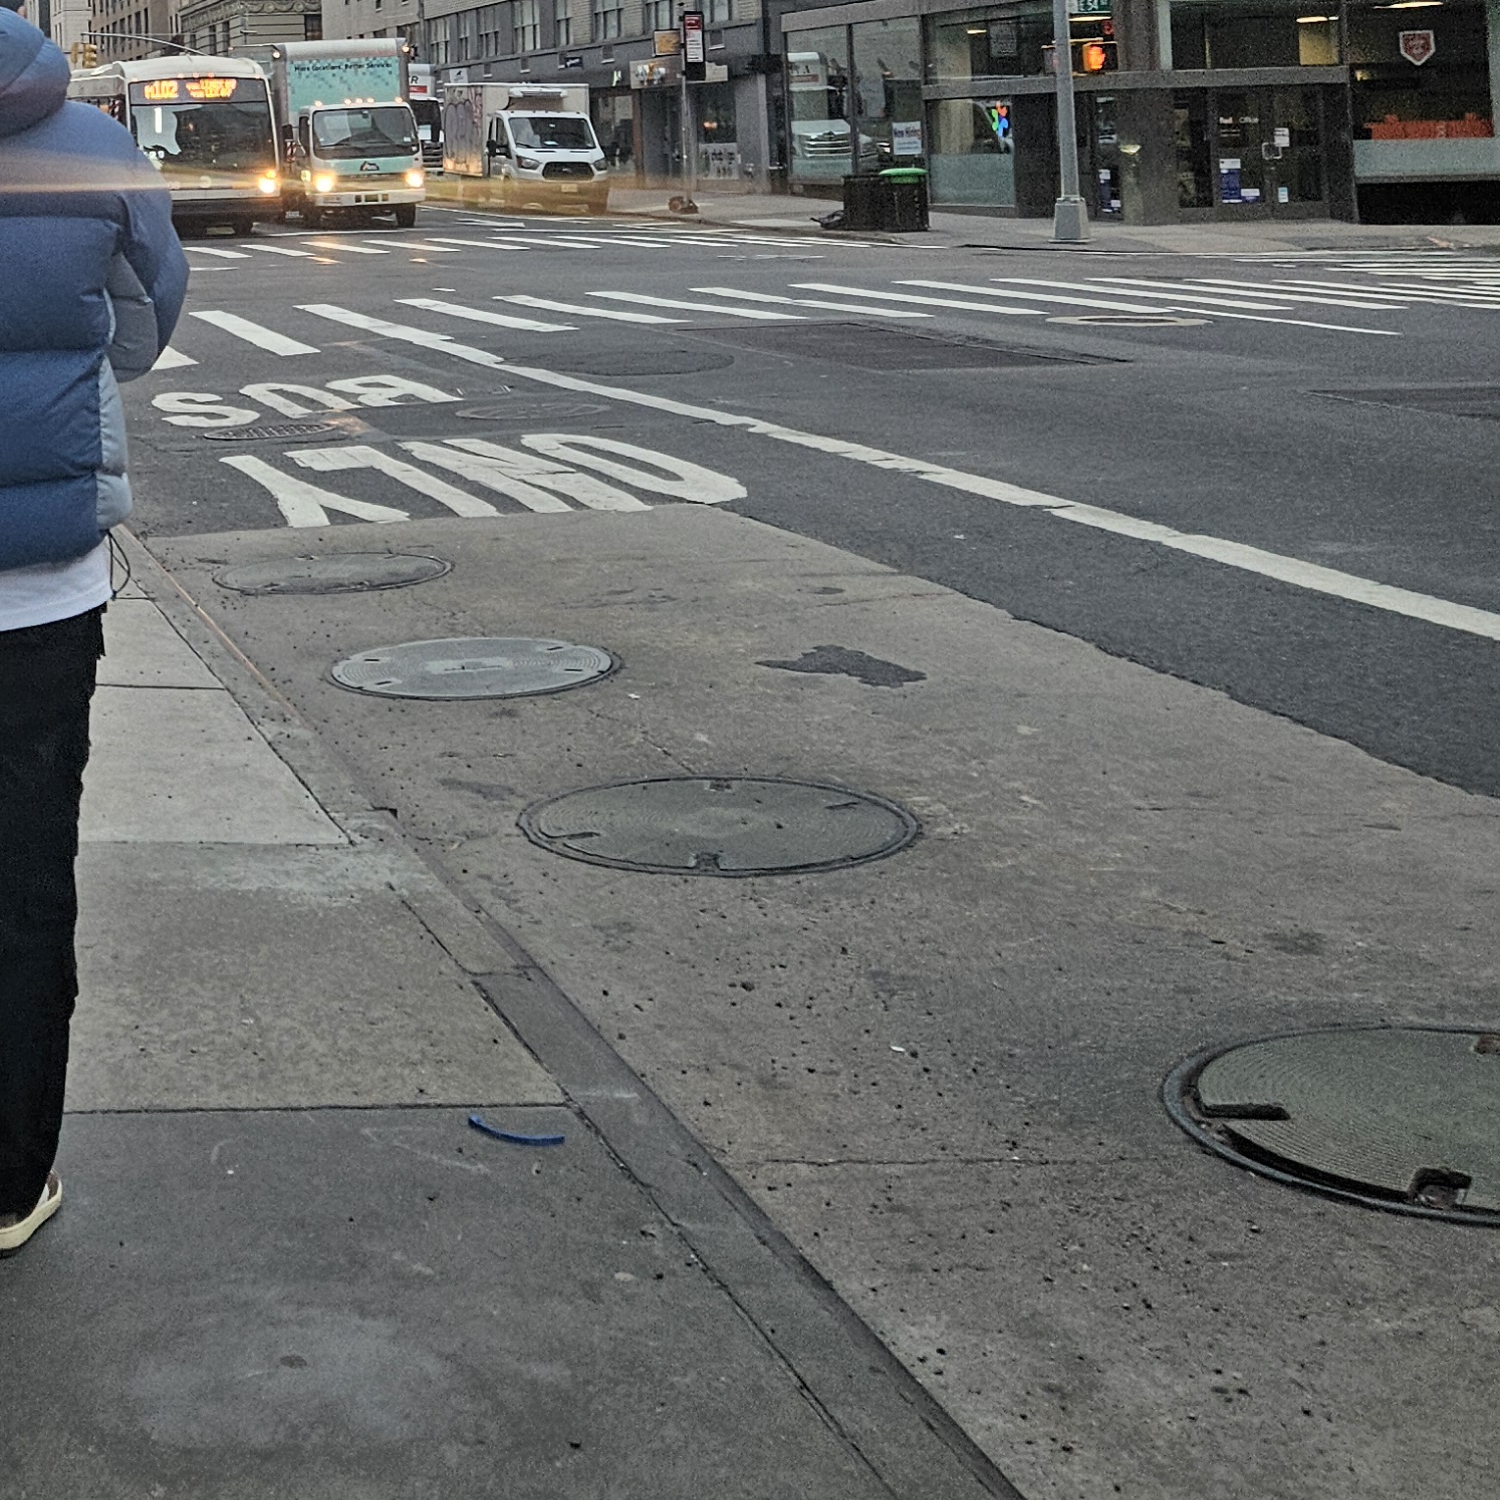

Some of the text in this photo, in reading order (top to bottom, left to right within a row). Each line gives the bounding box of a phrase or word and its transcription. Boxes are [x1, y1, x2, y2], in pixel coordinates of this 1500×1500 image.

[1086, 0, 1099, 11] 54
[144, 80, 179, 100] M102
[152, 374, 464, 428] BUS
[218, 432, 748, 529] ONLY
